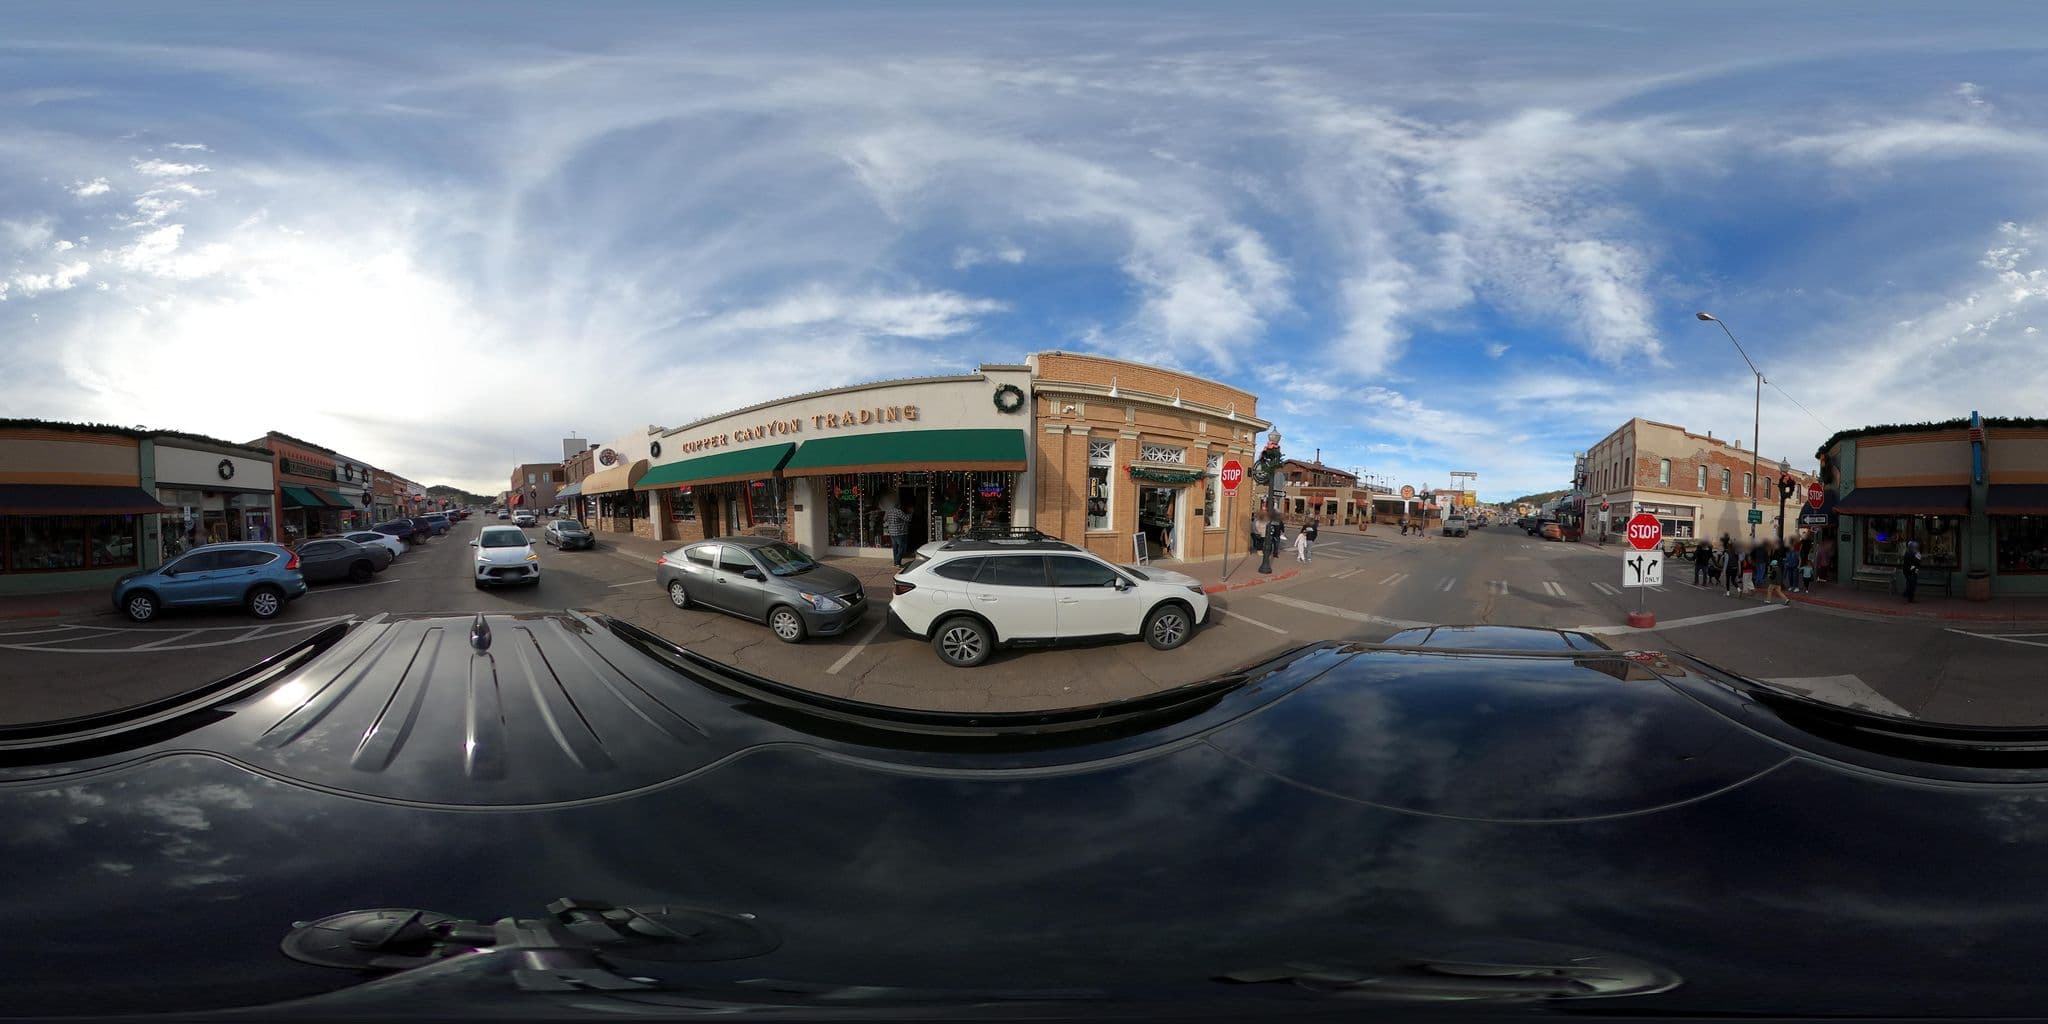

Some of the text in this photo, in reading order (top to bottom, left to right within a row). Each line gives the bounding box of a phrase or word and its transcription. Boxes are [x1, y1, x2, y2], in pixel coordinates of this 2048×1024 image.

[682, 405, 917, 454] COPPER CANYON TRADING
[1222, 469, 1241, 481] STOP
[1809, 490, 1823, 500] STOP
[1630, 524, 1659, 539] STOP
